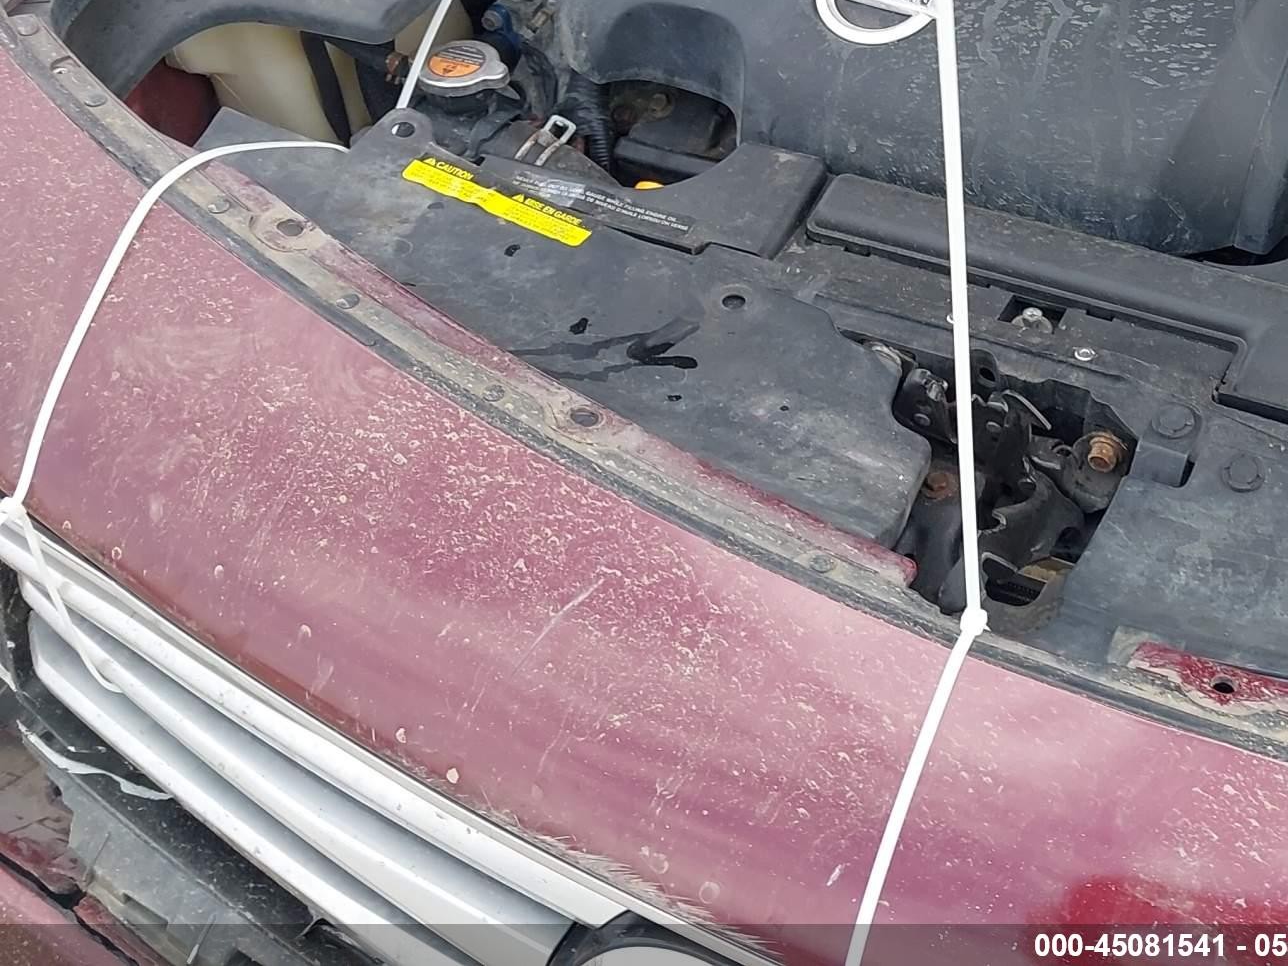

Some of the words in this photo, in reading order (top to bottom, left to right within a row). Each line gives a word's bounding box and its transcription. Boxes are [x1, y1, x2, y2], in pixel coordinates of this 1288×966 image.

[435, 159, 474, 181] CAUTION
[523, 196, 543, 210] MISE
[542, 204, 555, 215] EN
[553, 209, 582, 226] GARDE
